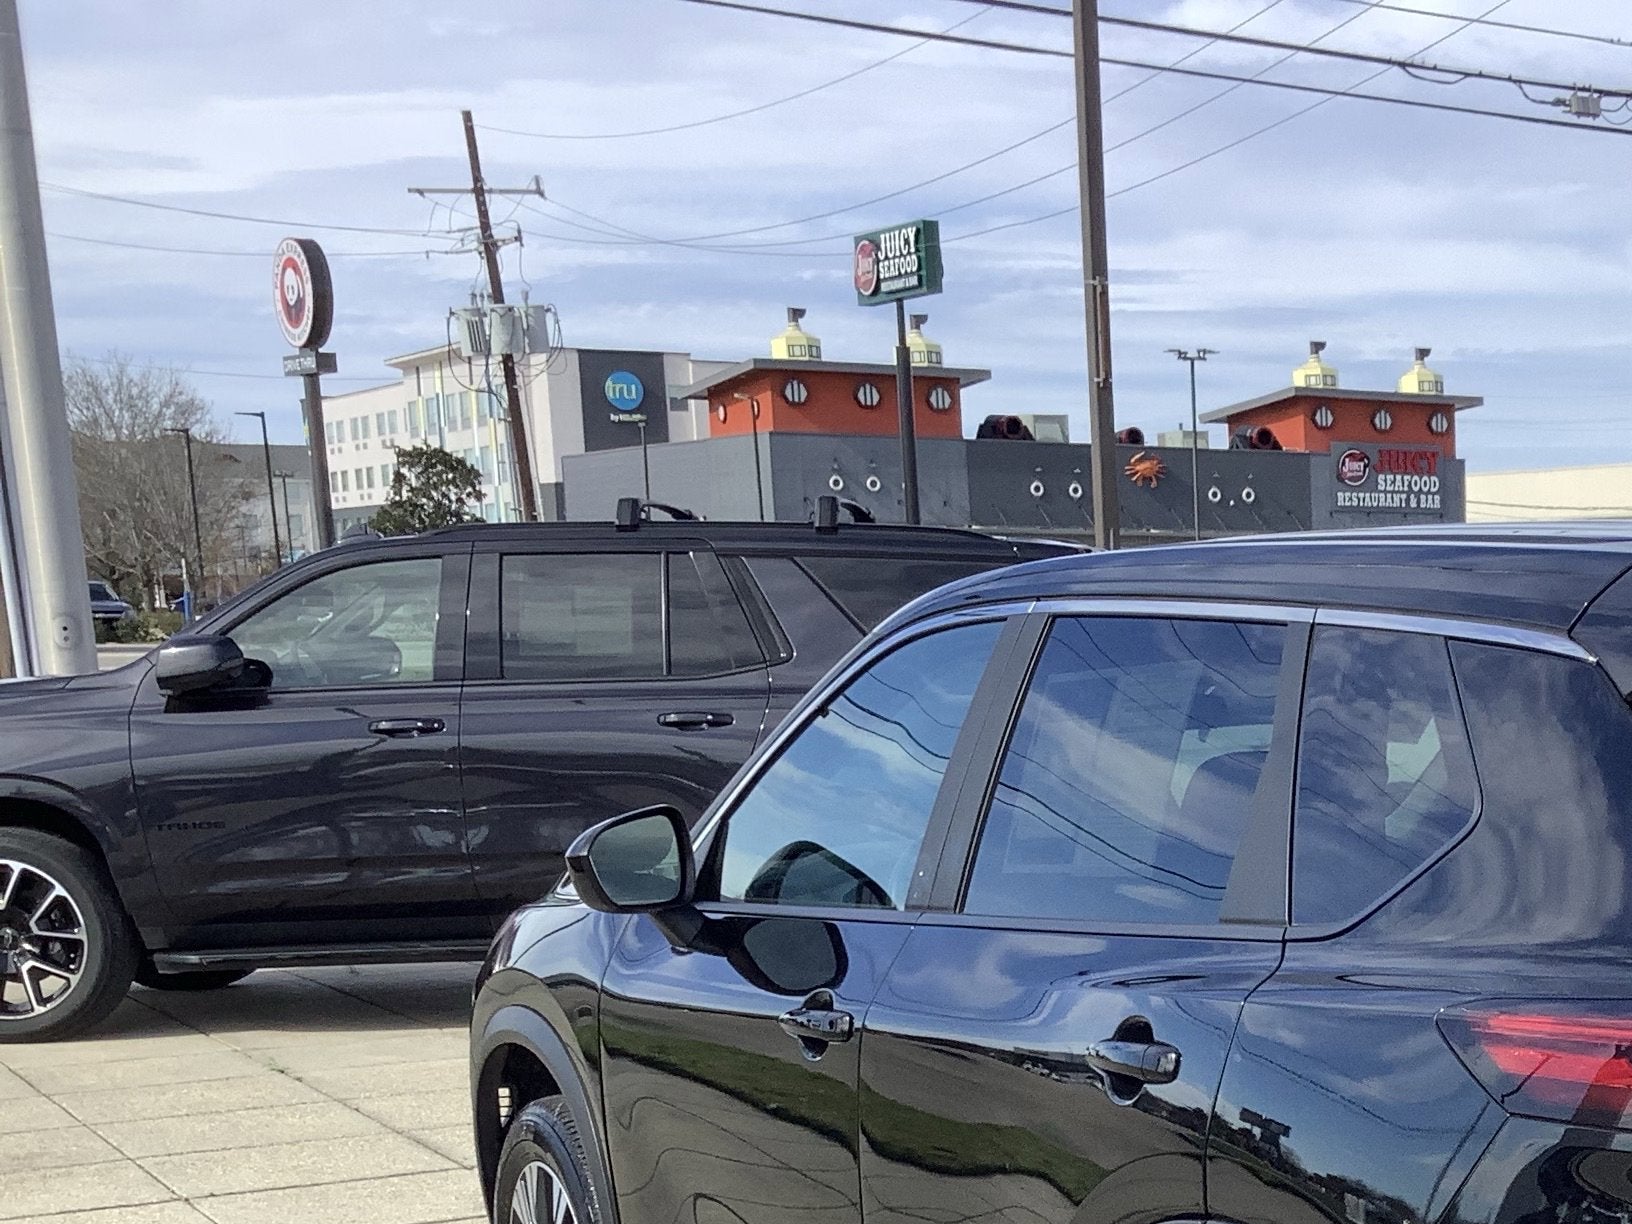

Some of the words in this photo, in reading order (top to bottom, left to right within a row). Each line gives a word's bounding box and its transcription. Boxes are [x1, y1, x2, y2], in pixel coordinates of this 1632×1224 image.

[877, 226, 917, 260] JUICY
[879, 254, 918, 279] SEAFOOD
[607, 379, 636, 400] tru
[1373, 449, 1439, 475] JUICY
[1377, 474, 1439, 492] SEAFOOD
[1336, 491, 1407, 508] RESTAURANT
[1409, 494, 1418, 508] &
[1420, 494, 1441, 508] BAR
